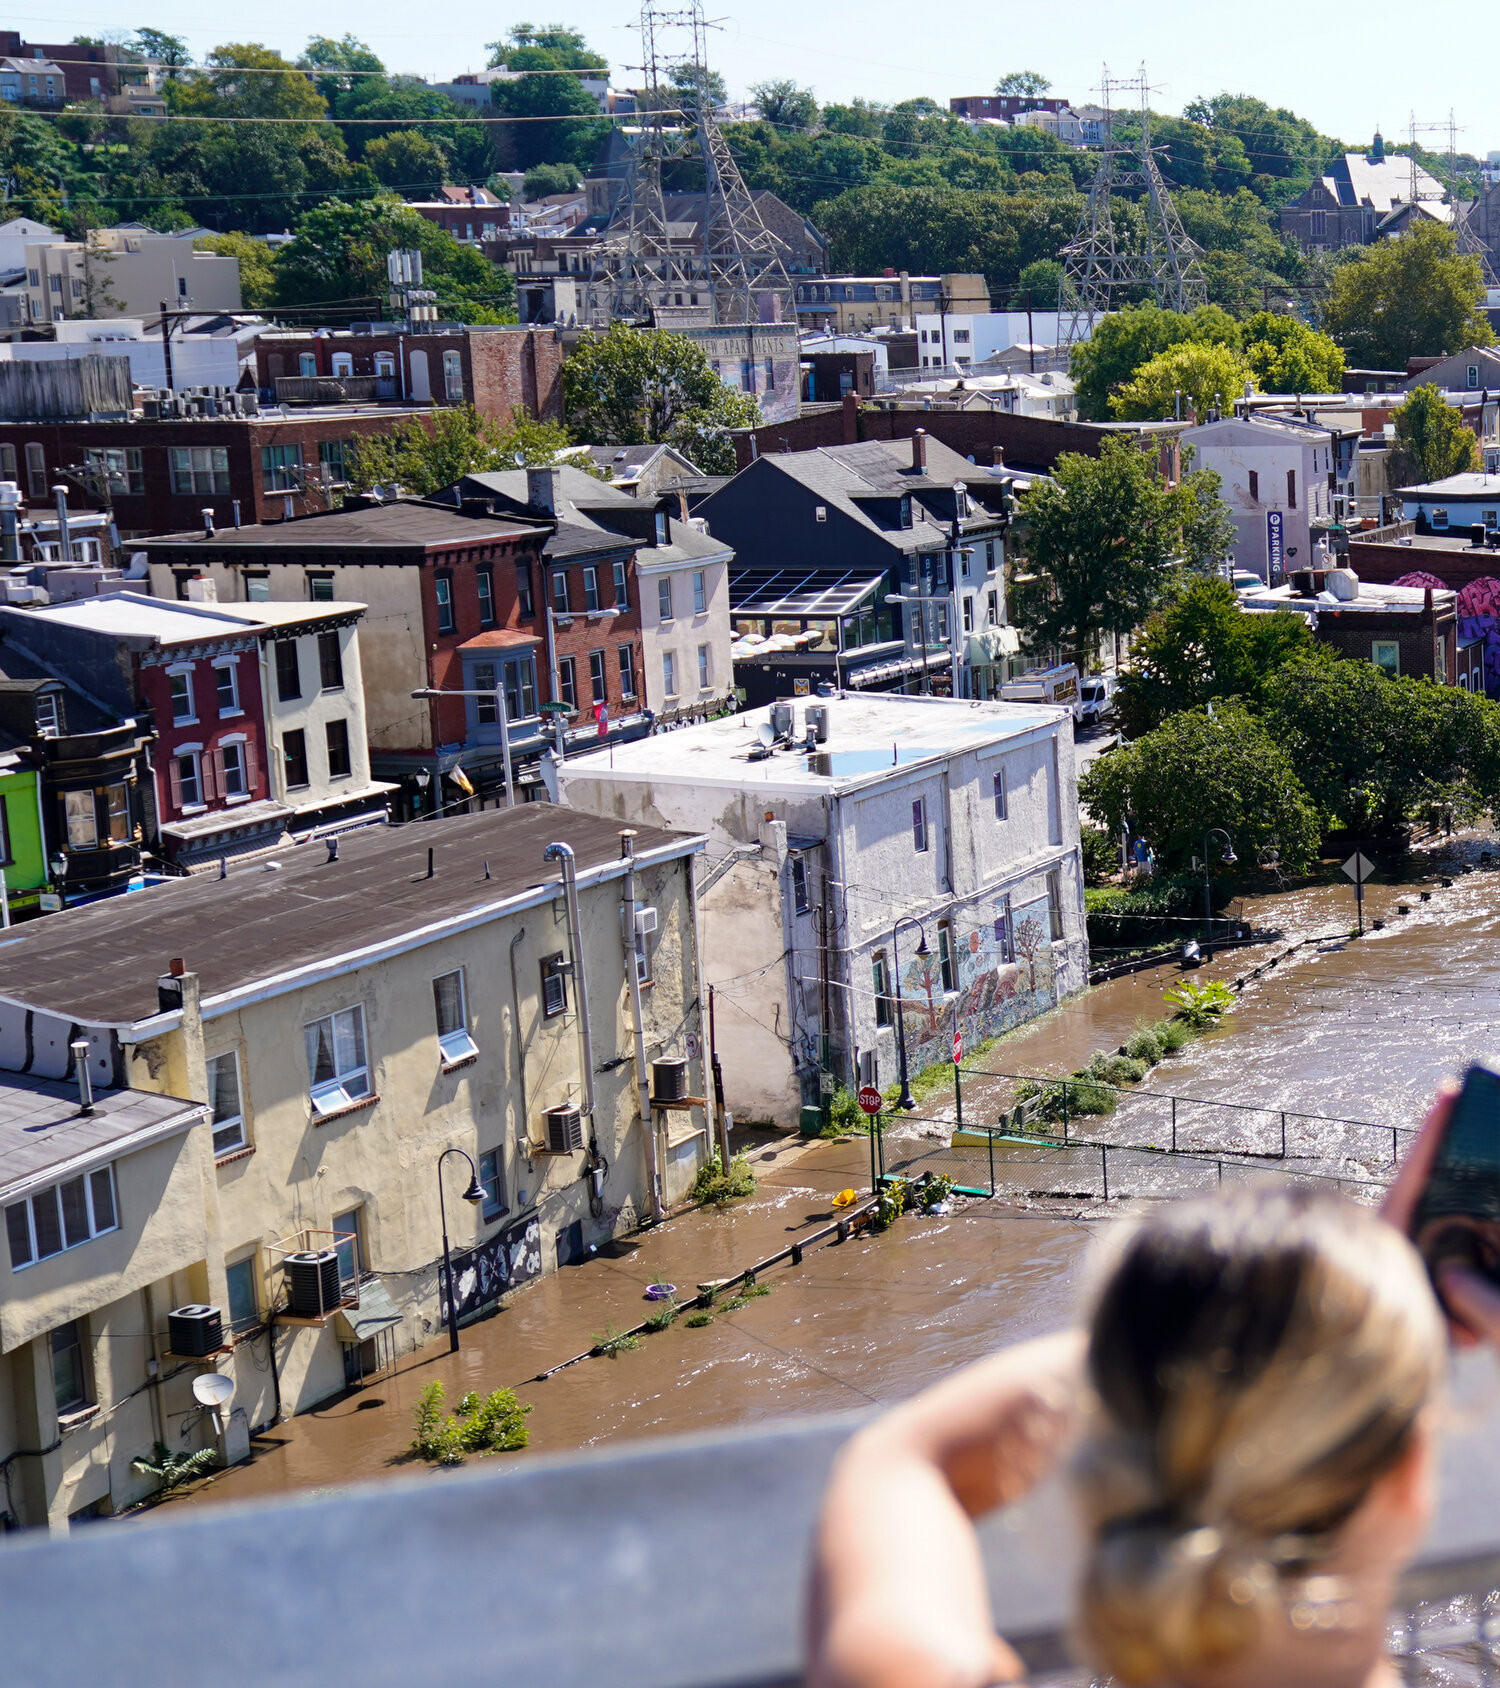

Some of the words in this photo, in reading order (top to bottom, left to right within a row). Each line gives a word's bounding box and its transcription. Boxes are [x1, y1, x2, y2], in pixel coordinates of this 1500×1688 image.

[723, 337, 784, 355] APARTMENTS
[1271, 526, 1281, 572] PARKING
[860, 1093, 881, 1106] STOP
